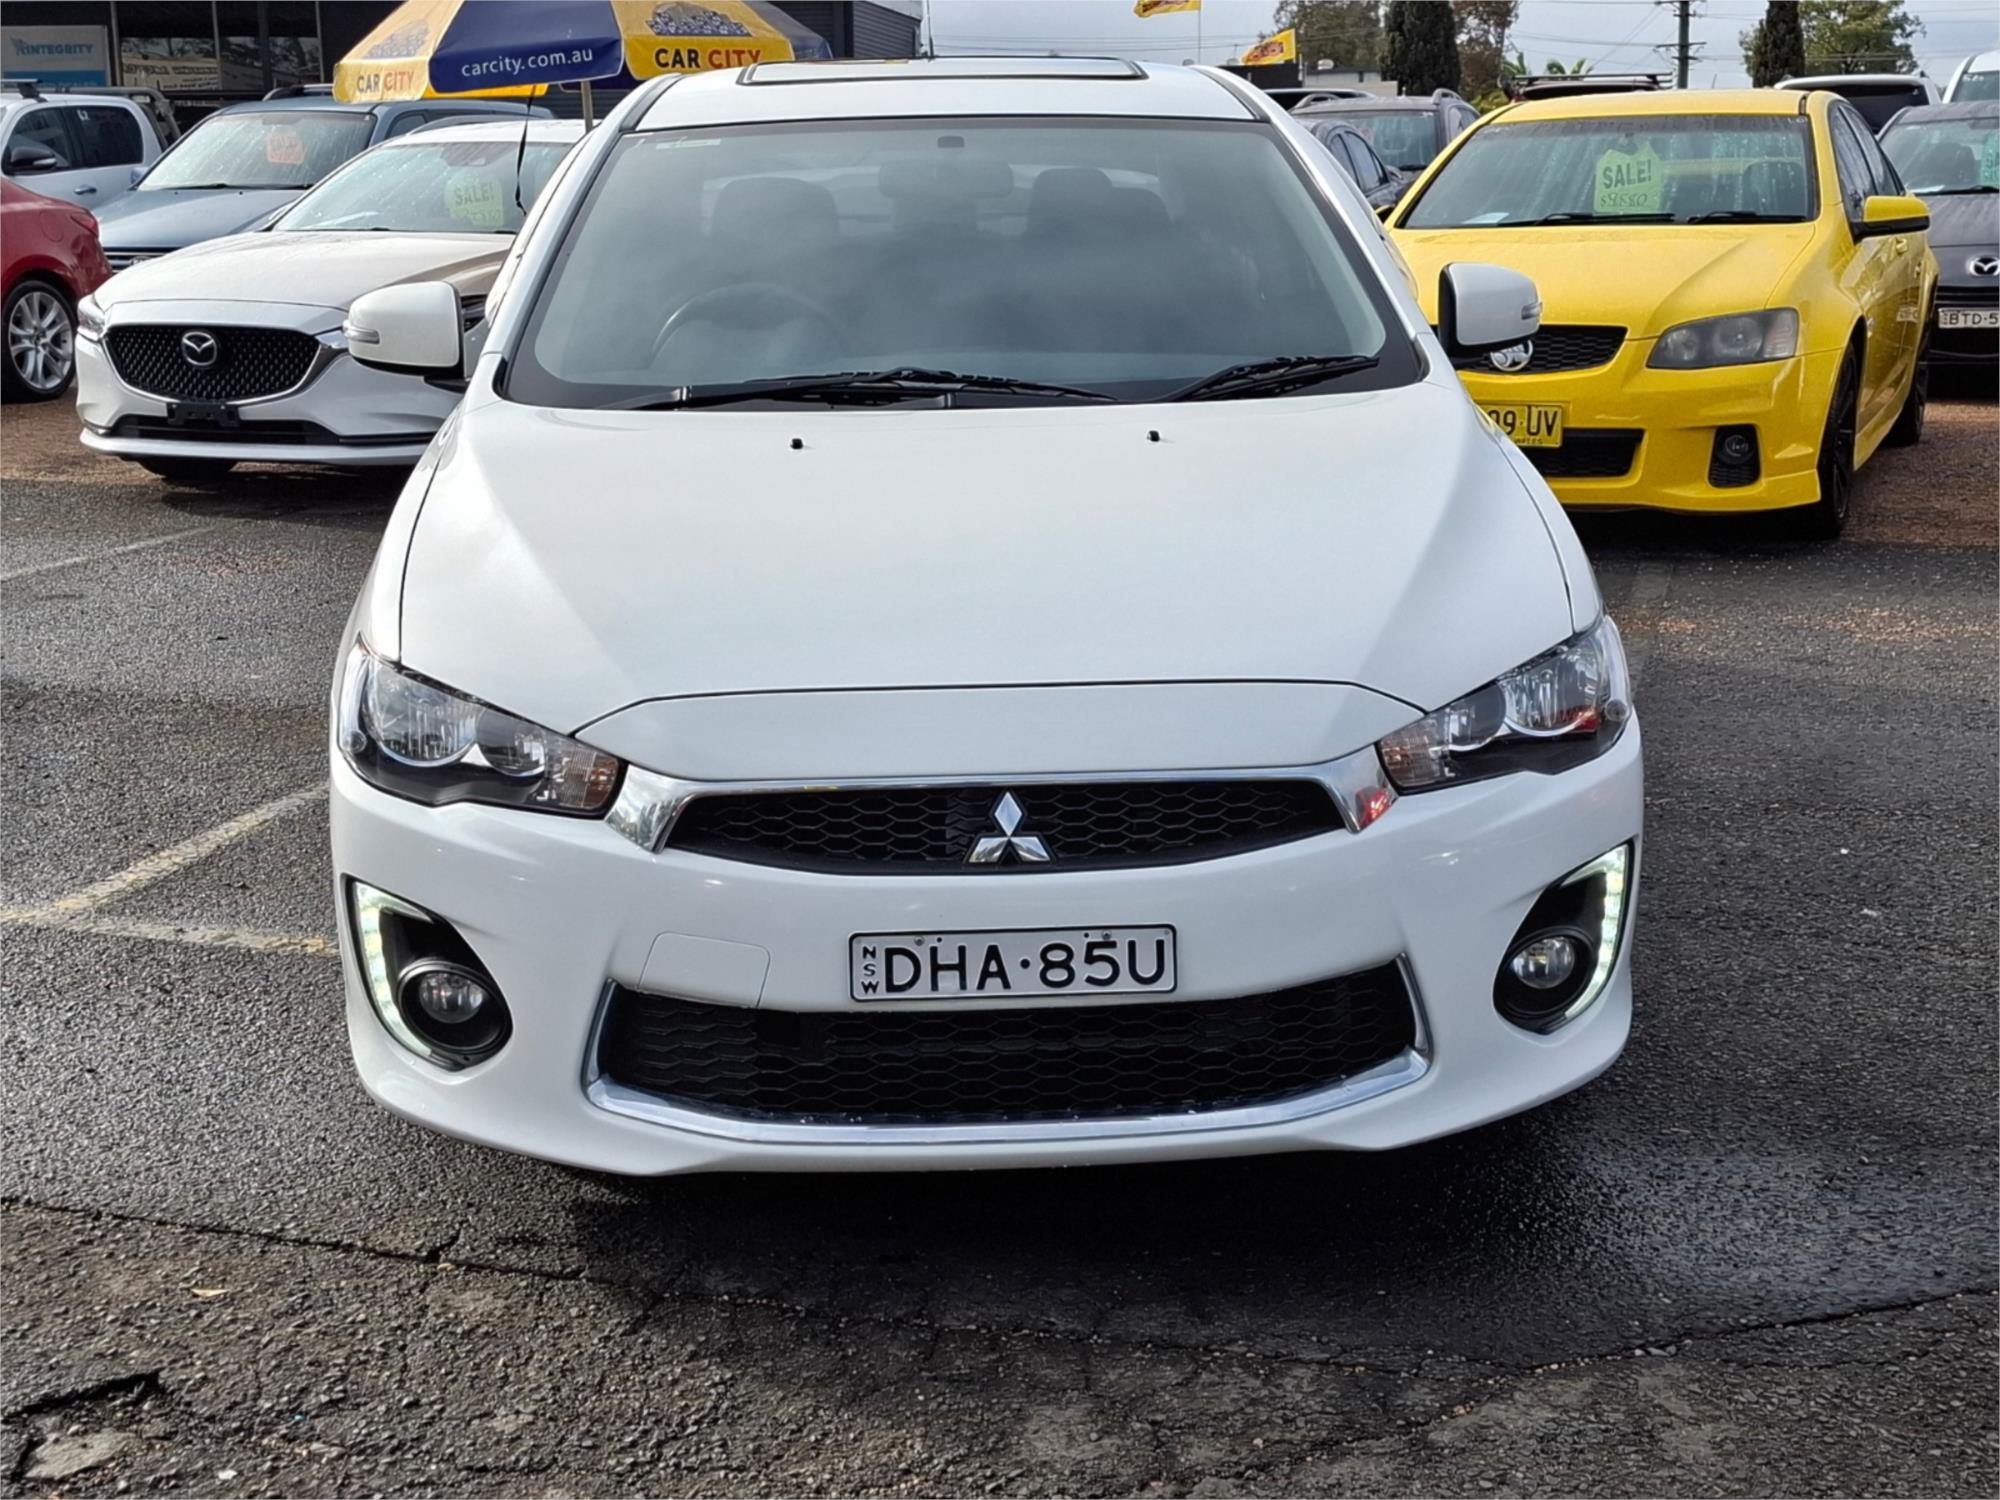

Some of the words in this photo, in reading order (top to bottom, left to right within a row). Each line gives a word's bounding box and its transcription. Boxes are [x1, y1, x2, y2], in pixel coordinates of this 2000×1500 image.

[26, 43, 94, 55] INTEGRITY
[655, 48, 701, 68] CAR
[708, 49, 761, 68] CITY
[461, 48, 593, 76] carcity.com.au
[356, 74, 380, 93] CAR
[383, 71, 415, 92] CITY
[1602, 159, 1652, 190] SALE!
[455, 182, 495, 206] SALE!
